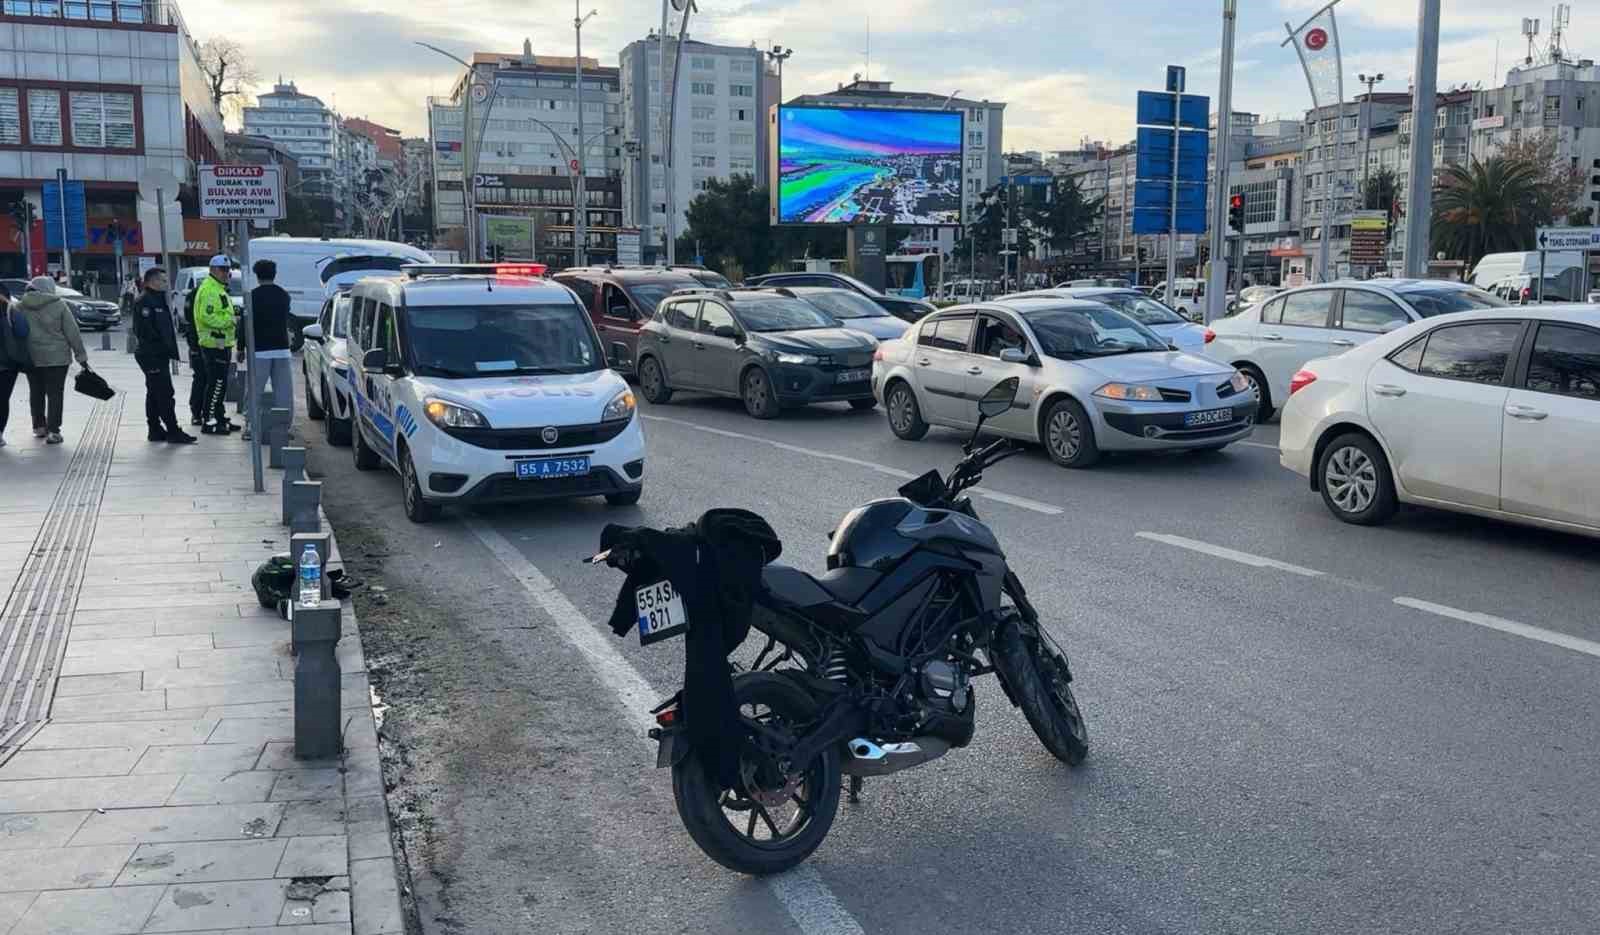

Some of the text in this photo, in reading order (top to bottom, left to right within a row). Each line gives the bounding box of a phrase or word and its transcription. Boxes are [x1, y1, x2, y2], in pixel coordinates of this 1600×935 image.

[207, 187, 272, 197] BULVAR AVM
[520, 459, 586, 475] 55 A 7532
[638, 590, 654, 610] 55
[649, 606, 671, 630] 871
